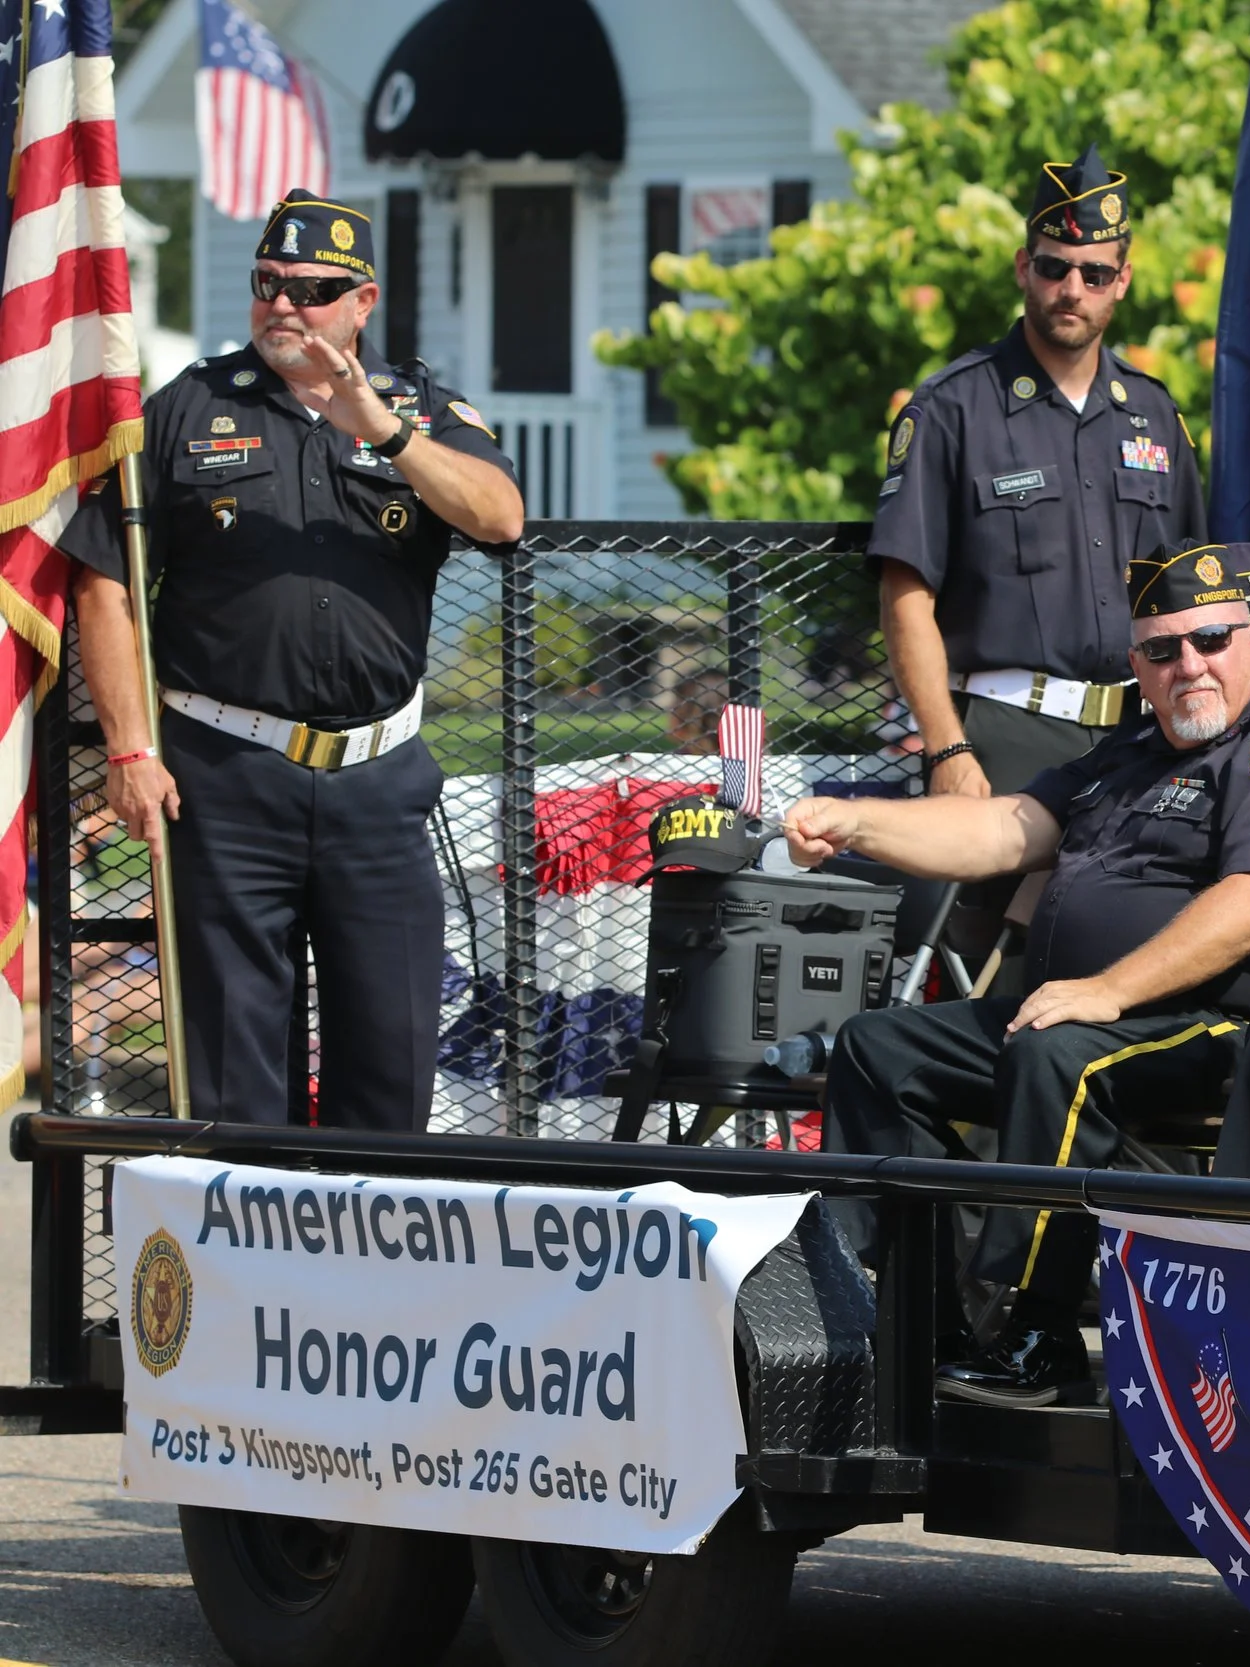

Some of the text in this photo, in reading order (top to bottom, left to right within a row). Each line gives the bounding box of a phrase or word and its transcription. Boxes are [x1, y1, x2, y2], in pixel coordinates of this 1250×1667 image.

[1092, 226, 1118, 241] GATE
[315, 249, 366, 273] KINGSPORT,
[203, 452, 241, 465] WINEGAR
[999, 474, 1039, 490] SCHWANDT
[1151, 604, 1158, 614] 3
[658, 807, 724, 844] RMY
[807, 966, 839, 980] YETI
[197, 1170, 718, 1292] American Legion
[140, 1240, 187, 1289] AMERICAN
[1142, 1257, 1227, 1315] 1776
[142, 1336, 178, 1363] LEGION
[255, 1304, 637, 1422] Honor Guard
[151, 1417, 678, 1520] Post 3 Kingsport, Post 265 Gate City
